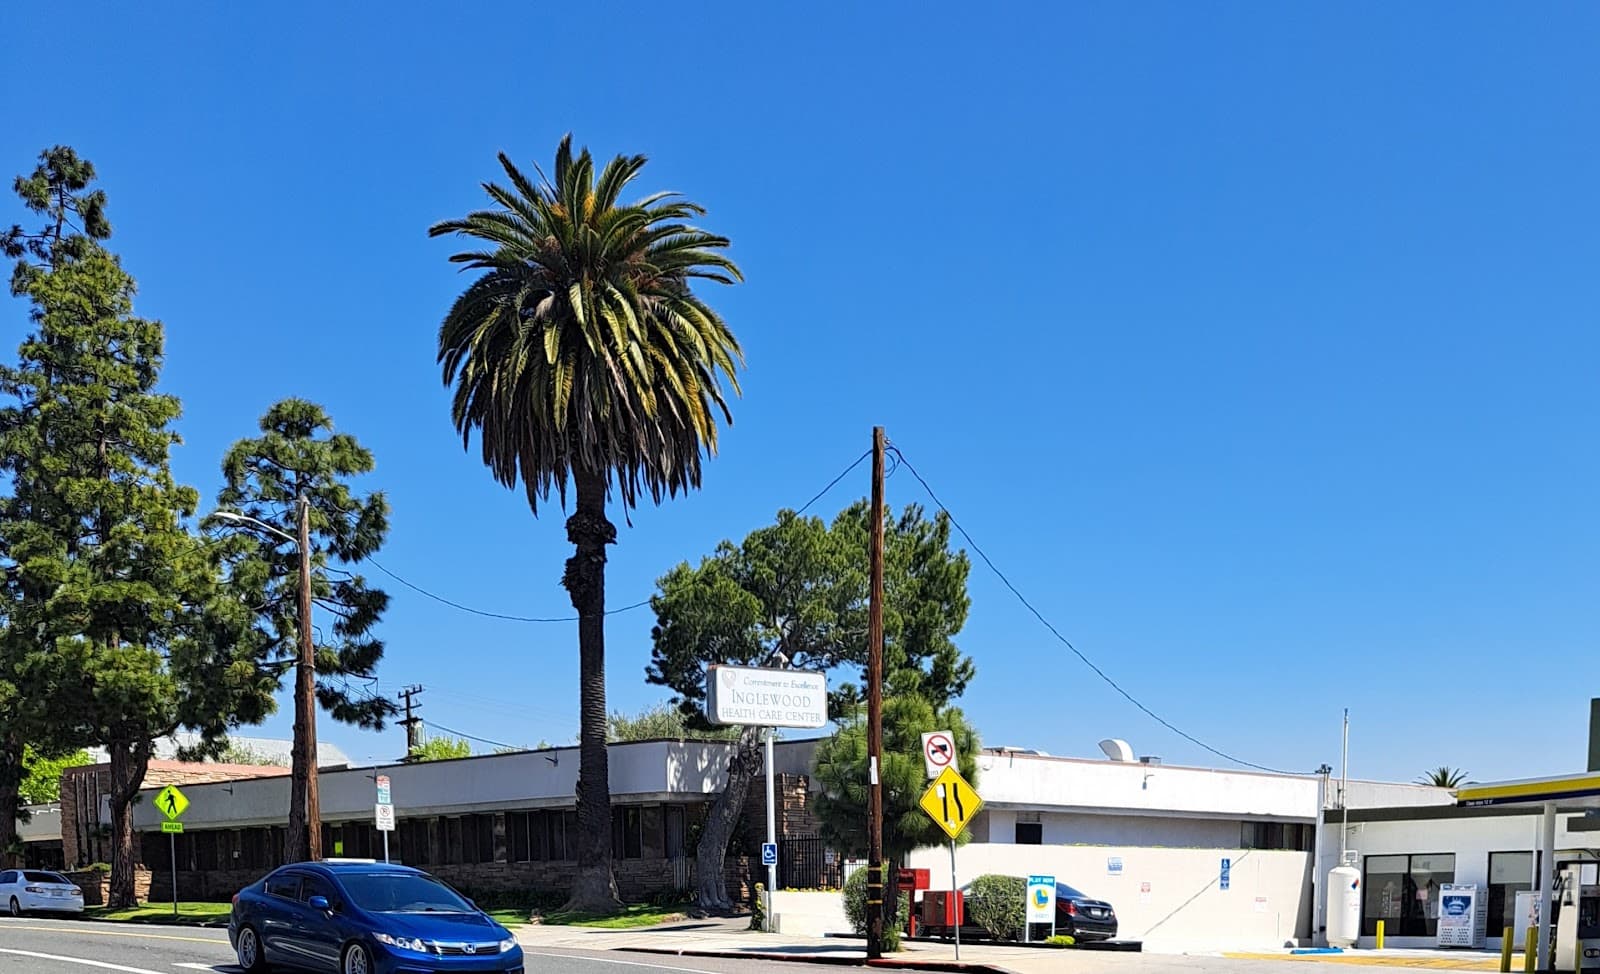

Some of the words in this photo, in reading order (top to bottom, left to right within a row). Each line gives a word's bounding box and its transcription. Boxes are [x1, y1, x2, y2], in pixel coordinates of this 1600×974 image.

[743, 676, 782, 688] Commitment
[791, 680, 819, 690] Excellence
[731, 689, 811, 708] INGLEWOOD
[722, 707, 756, 719] HEALTH
[758, 710, 782, 721] CARE
[785, 712, 822, 723] CENTER
